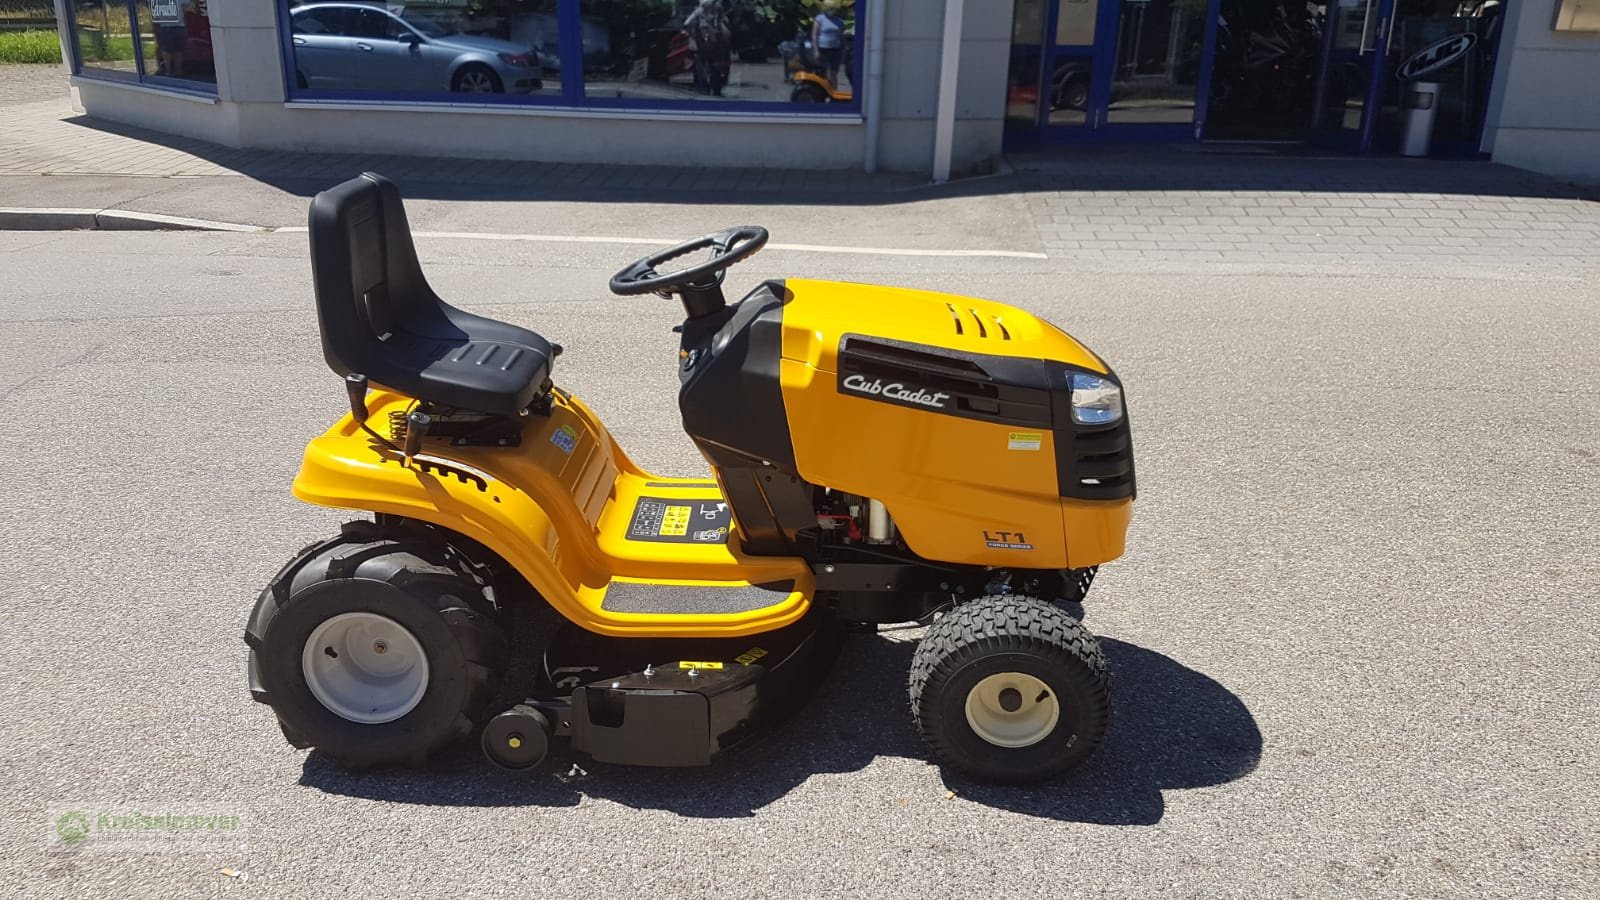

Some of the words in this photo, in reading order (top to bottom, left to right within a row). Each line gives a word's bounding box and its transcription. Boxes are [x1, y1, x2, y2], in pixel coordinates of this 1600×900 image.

[843, 374, 882, 394] Cub
[882, 383, 950, 408] Cadet
[983, 530, 1025, 543] LT1
